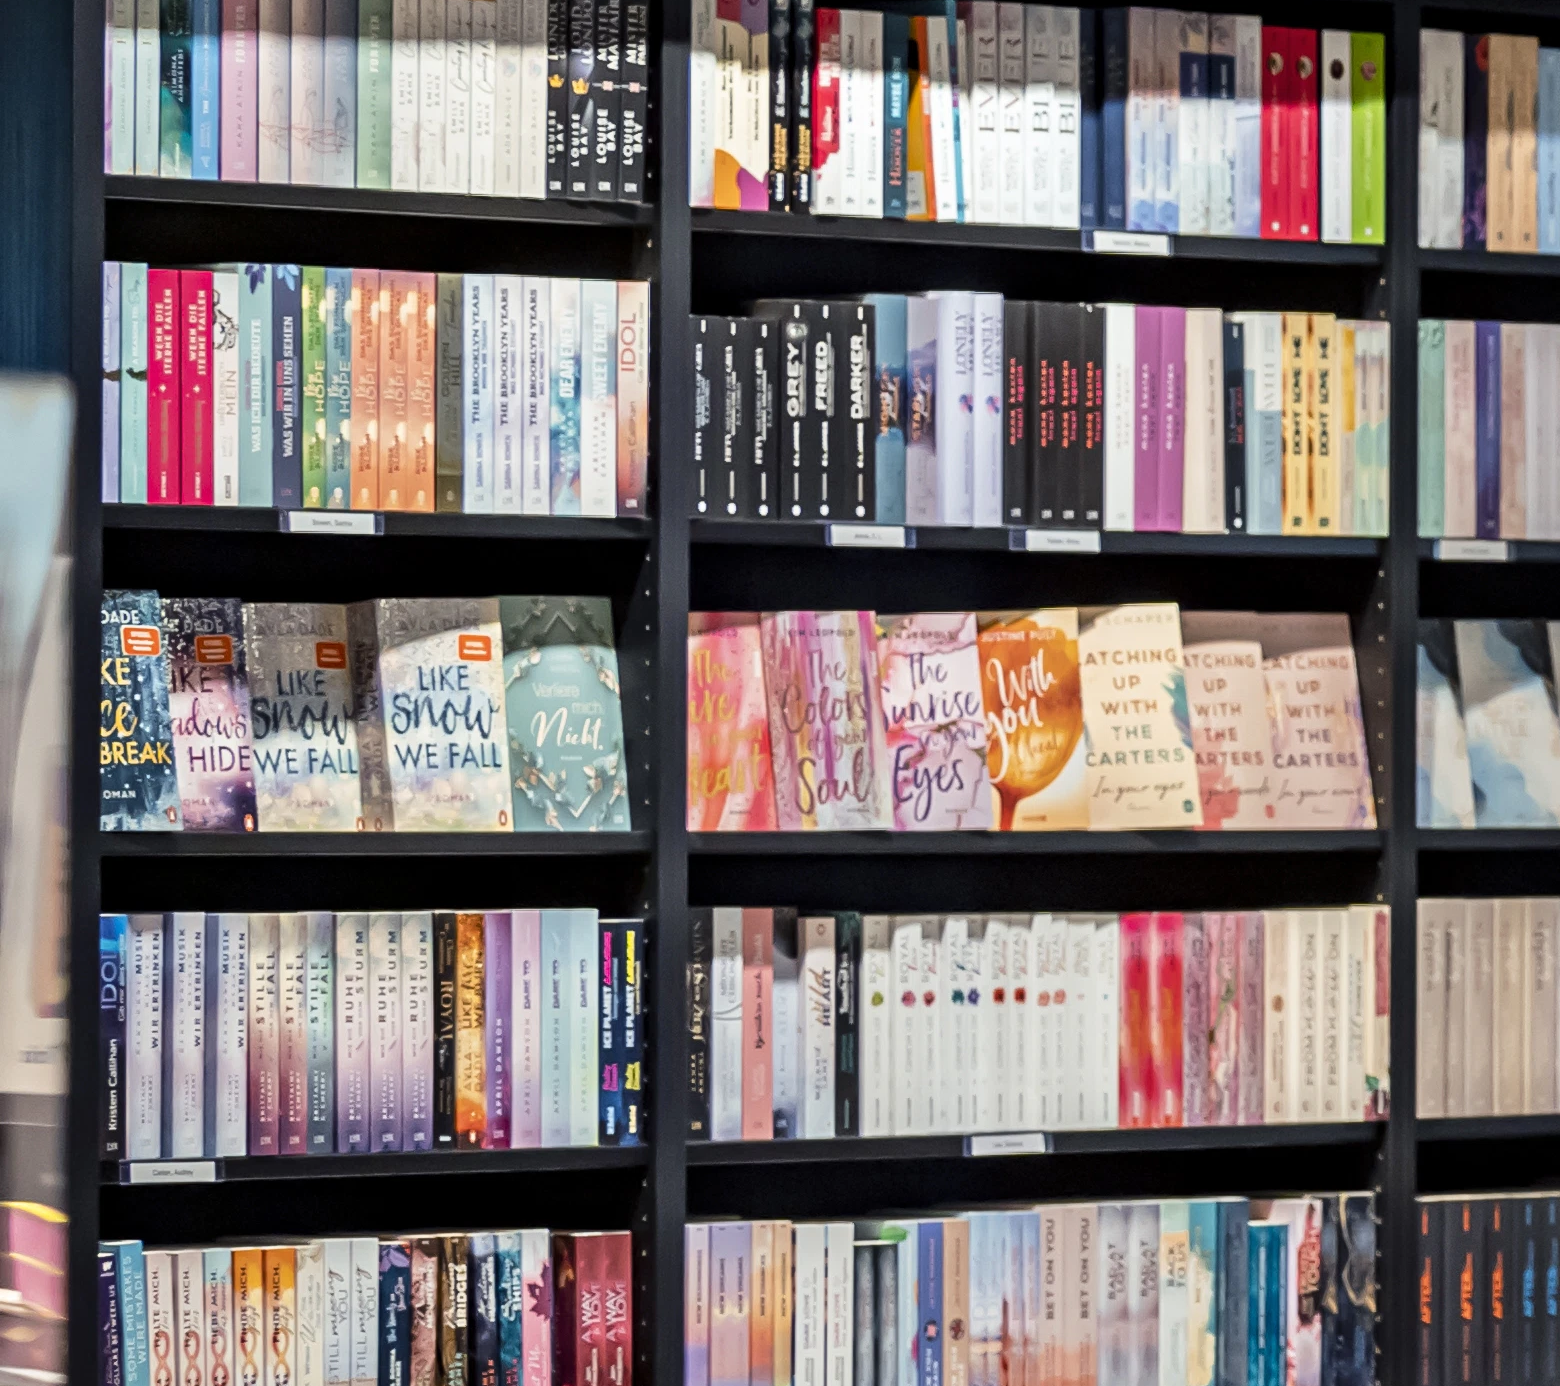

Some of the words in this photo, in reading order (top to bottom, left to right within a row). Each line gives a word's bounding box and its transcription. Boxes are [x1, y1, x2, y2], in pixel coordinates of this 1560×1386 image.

[621, 314, 637, 372] IDOL
[786, 344, 801, 417] GREY
[815, 341, 828, 411] FREED
[850, 335, 864, 420] DARKER
[276, 669, 327, 697] LIKE
[418, 665, 469, 692] LIKE
[986, 649, 1058, 700] With
[1112, 675, 1142, 691] UP
[251, 698, 354, 746] Snow
[392, 692, 500, 740] Snow
[1101, 699, 1158, 715] WITH
[100, 742, 172, 765] BREAK
[1111, 724, 1152, 741] THE
[188, 746, 251, 773] HIDE
[254, 749, 299, 774] WE
[308, 749, 359, 775] FALL
[395, 743, 439, 769] WE
[450, 743, 502, 768] FALL
[1085, 747, 1185, 768] CARTERS
[796, 747, 872, 814] Soul
[894, 743, 966, 822] Eyes
[108, 1038, 118, 1087] Callihan
[108, 1089, 118, 1131] Kristen
